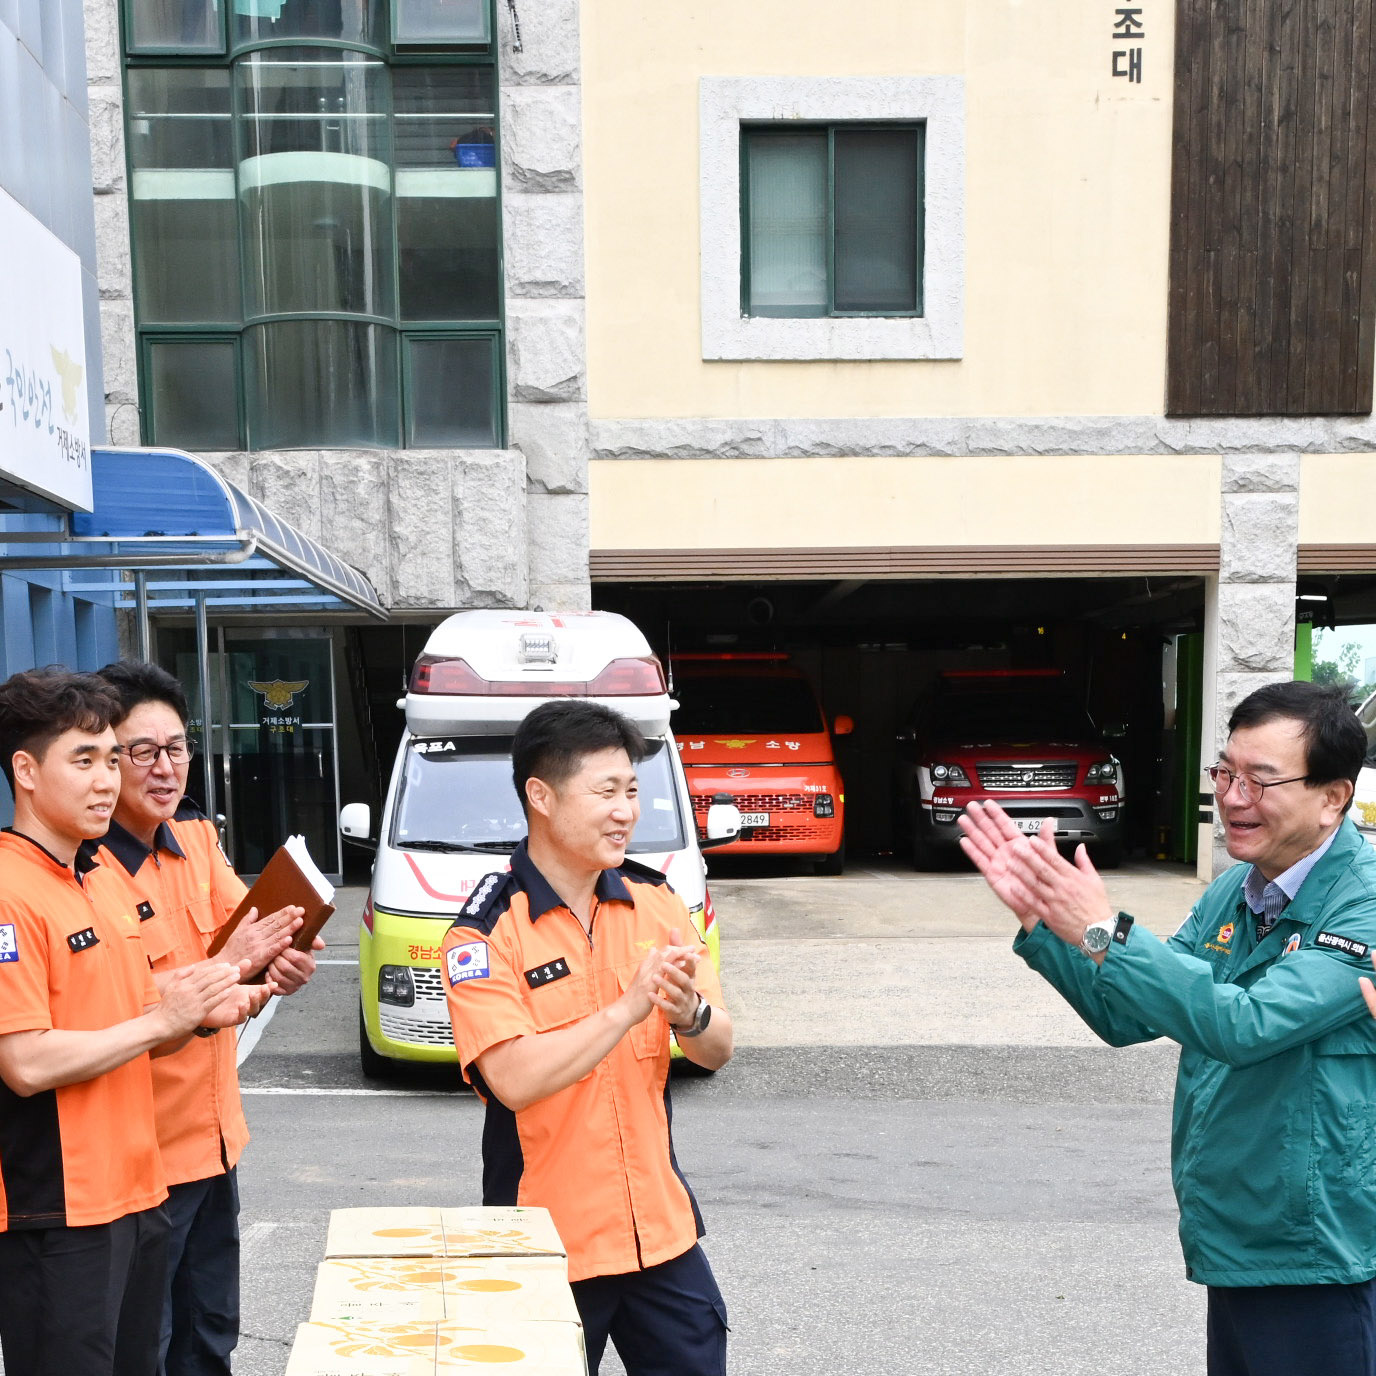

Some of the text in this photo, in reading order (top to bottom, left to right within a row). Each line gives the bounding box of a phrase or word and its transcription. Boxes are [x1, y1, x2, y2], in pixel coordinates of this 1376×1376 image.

[6, 348, 54, 435] 국민안전
[56, 426, 87, 471] 거제소방서
[262, 716, 300, 726] 거제소방서
[270, 725, 294, 734] 구조대
[765, 740, 800, 751] 소방
[1318, 932, 1366, 955] 울산광역시 의회
[452, 968, 483, 983] KOREA
